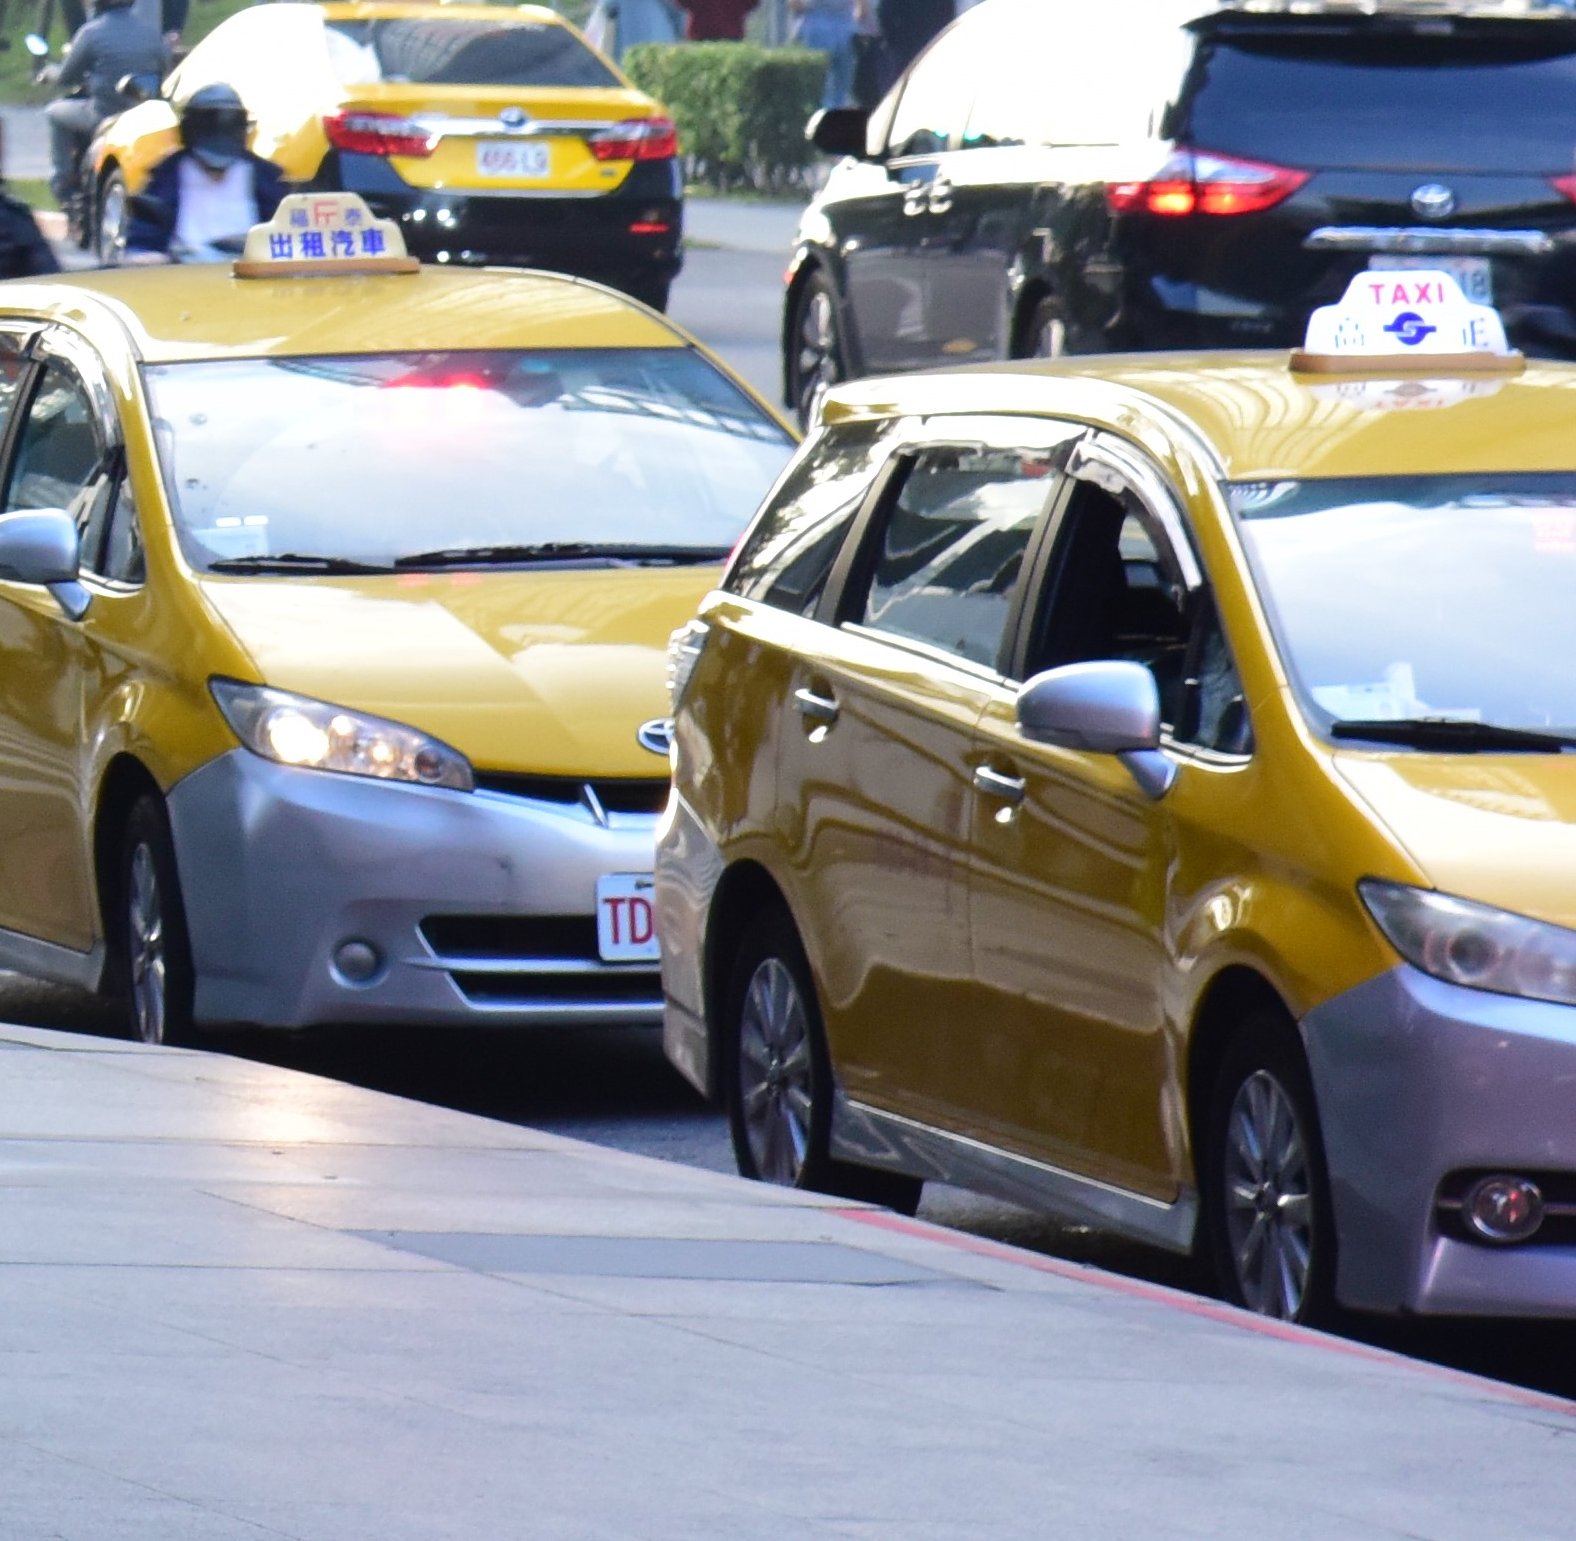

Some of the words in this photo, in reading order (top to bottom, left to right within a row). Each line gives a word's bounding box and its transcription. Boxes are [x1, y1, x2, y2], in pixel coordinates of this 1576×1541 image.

[269, 228, 386, 259] 出租汽車
[1368, 282, 1444, 305] TAXI
